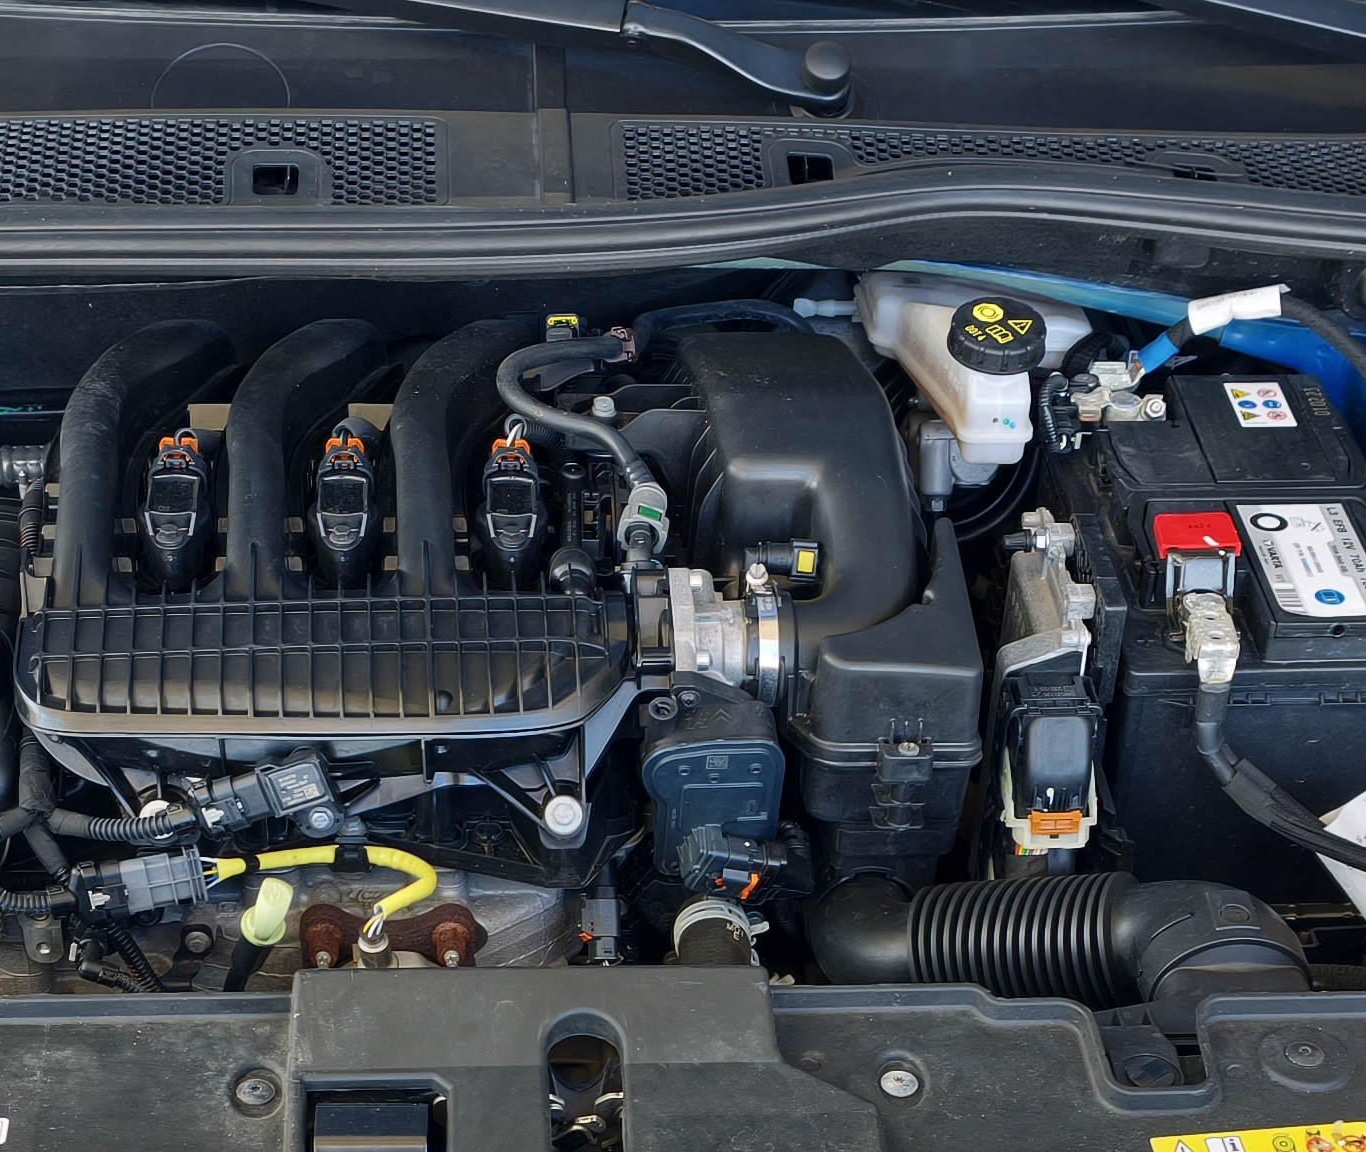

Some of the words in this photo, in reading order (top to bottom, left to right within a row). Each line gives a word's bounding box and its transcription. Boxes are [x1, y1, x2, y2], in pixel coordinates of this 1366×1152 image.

[1266, 542, 1283, 569] VARTA
[1341, 538, 1357, 551] 12V
[1349, 554, 1366, 573] 70Ah
